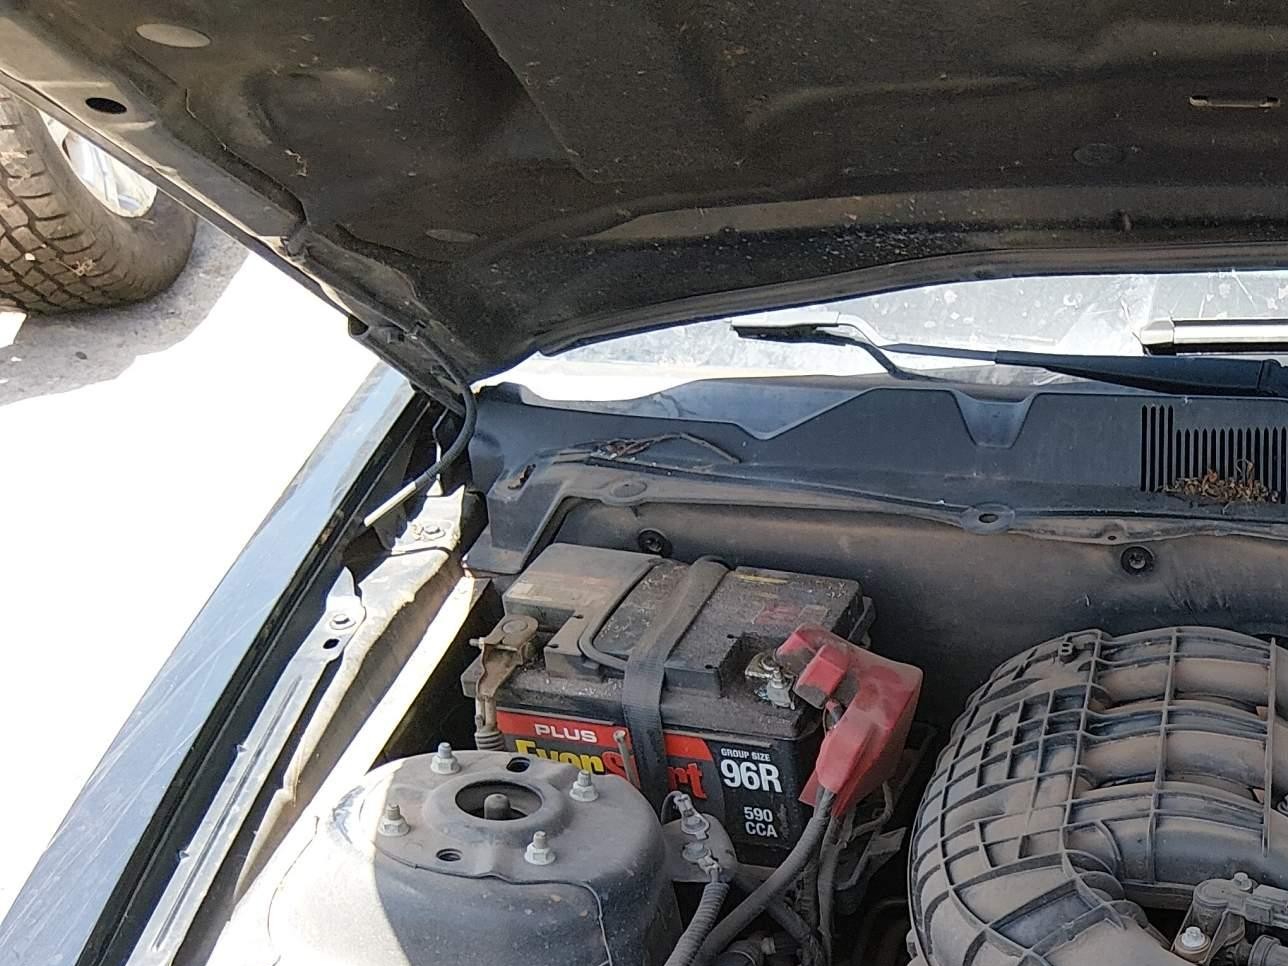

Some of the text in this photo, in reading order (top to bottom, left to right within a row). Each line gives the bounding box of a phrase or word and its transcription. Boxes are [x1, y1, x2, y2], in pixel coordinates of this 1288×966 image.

[533, 723, 598, 743] PLUS
[720, 747, 771, 762] GROUP SIZE
[720, 759, 783, 793] 96R
[743, 806, 773, 823] 590
[745, 821, 778, 838] CCA
